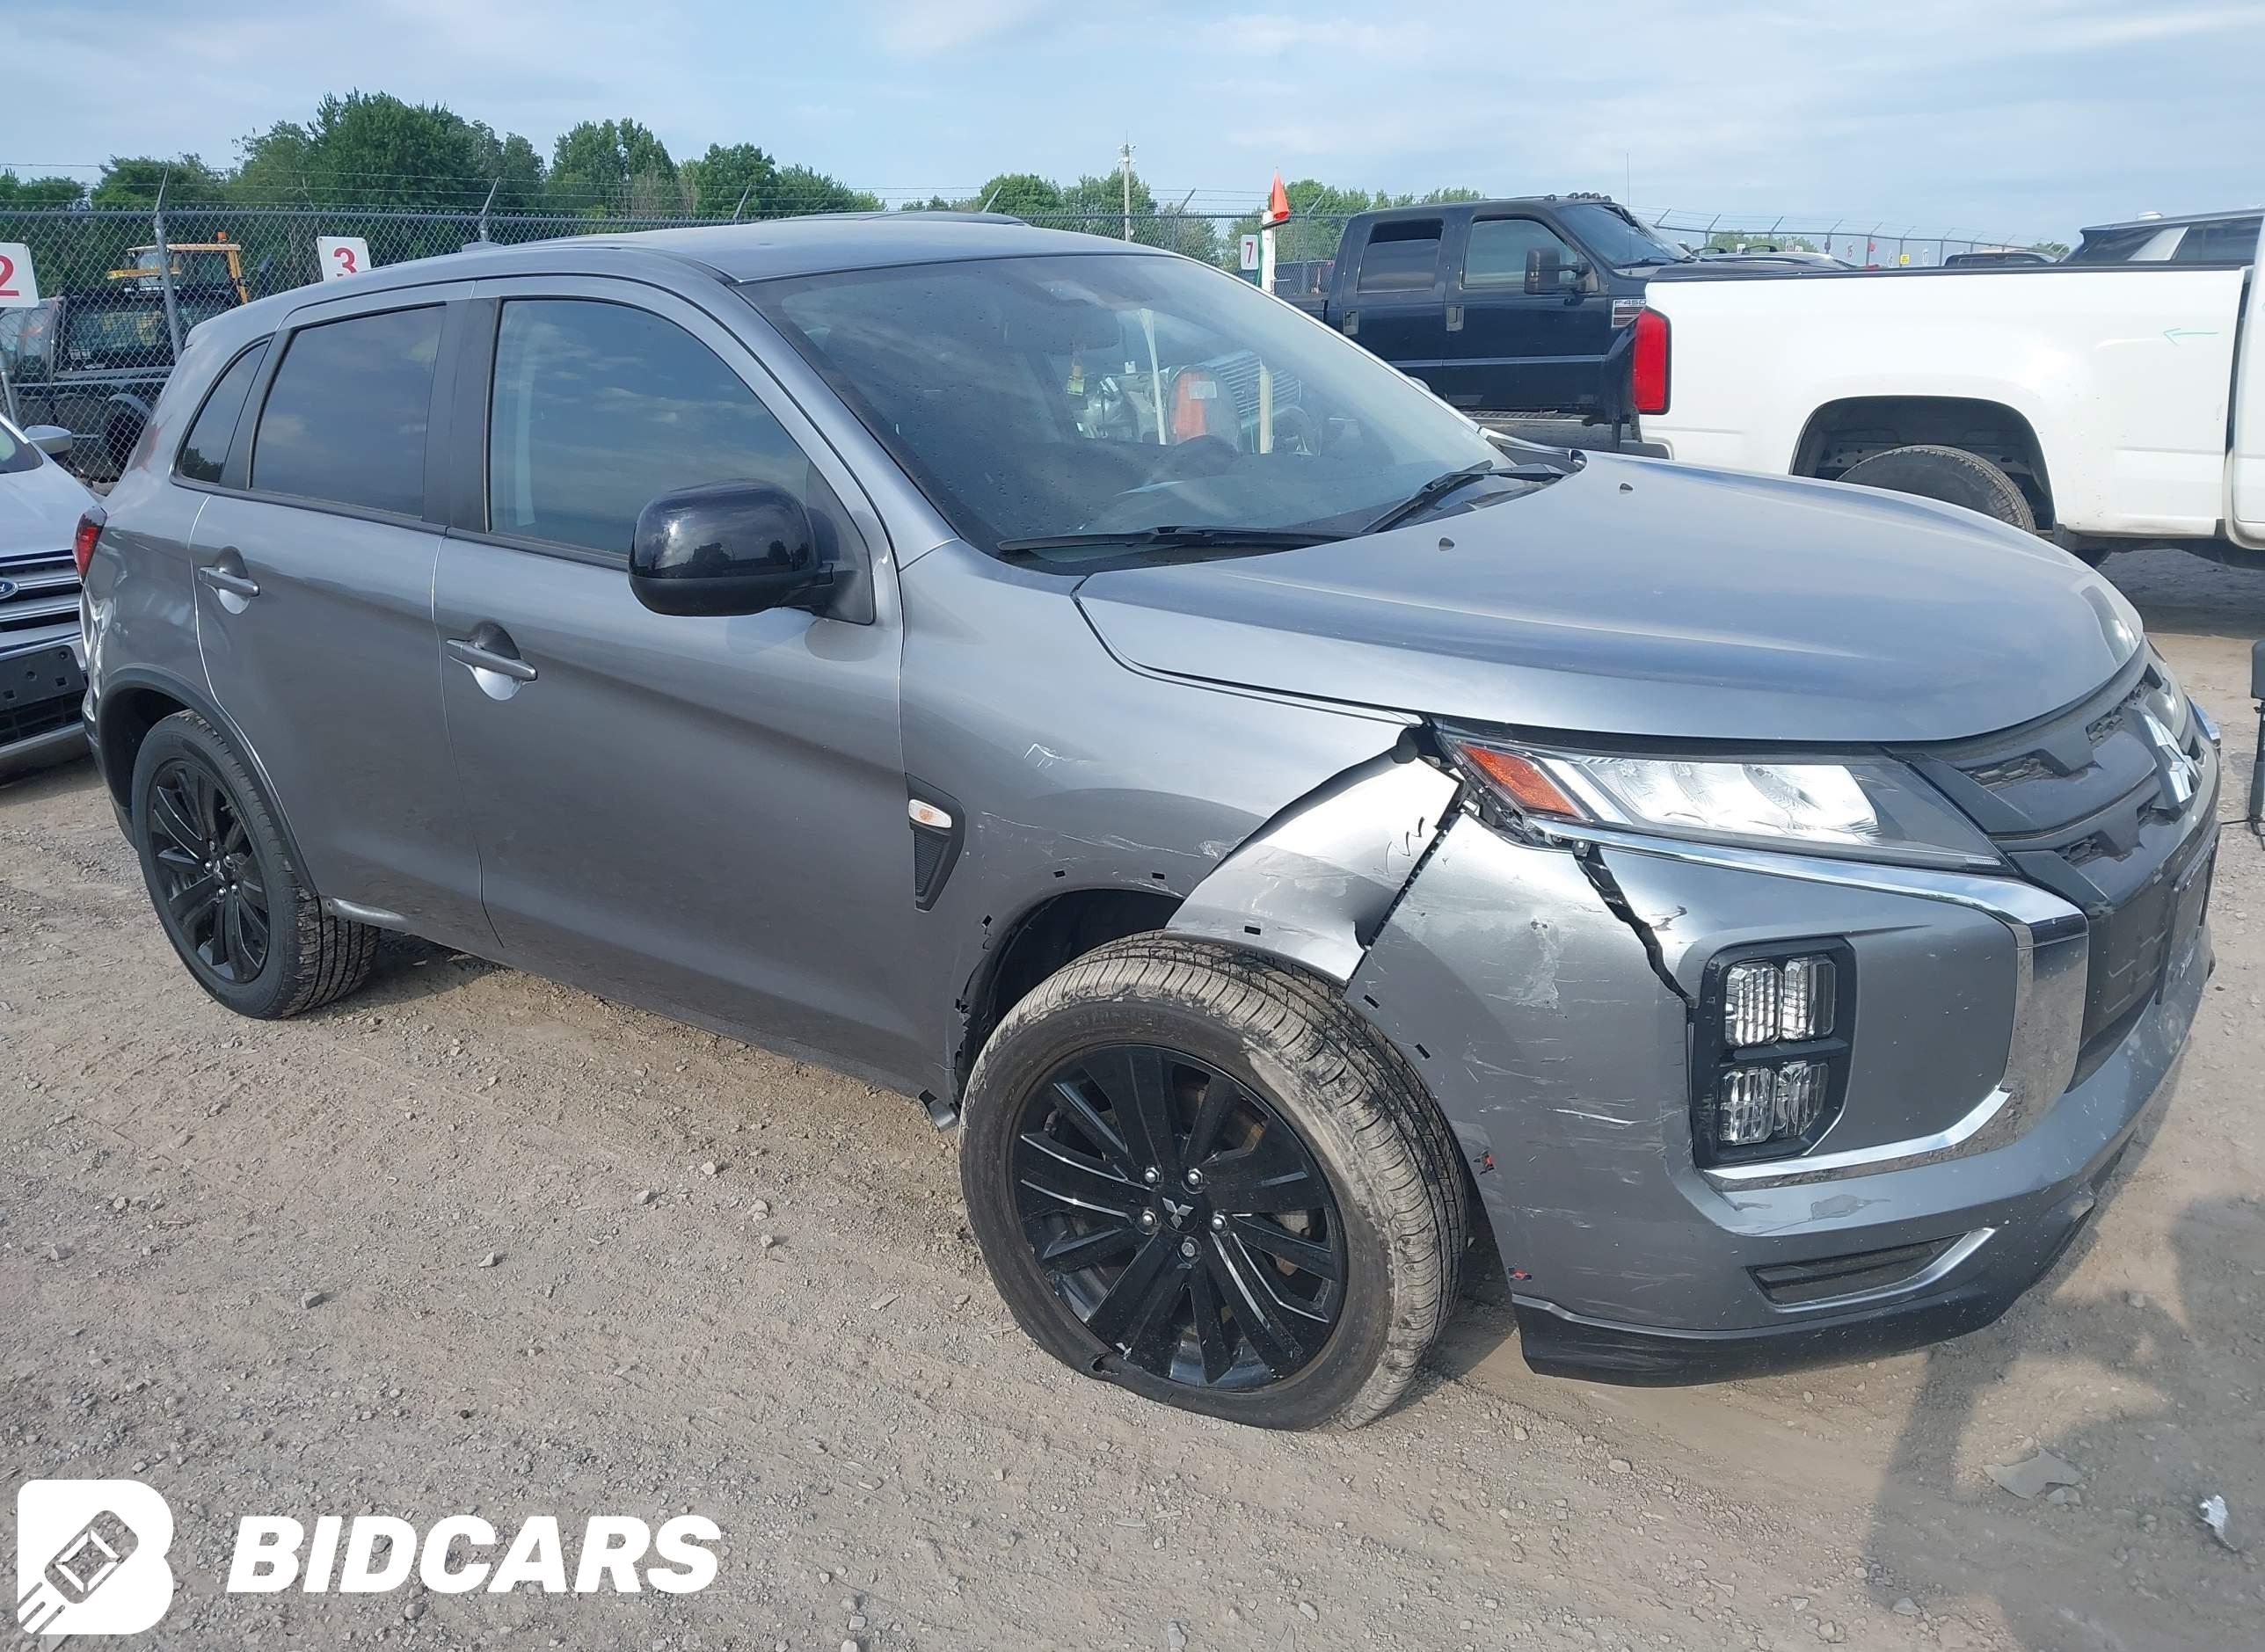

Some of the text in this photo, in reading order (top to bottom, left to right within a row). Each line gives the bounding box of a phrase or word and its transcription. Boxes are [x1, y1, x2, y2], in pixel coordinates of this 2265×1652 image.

[333, 247, 357, 277] 3
[1245, 241, 1253, 264] 7
[0, 255, 19, 295] 2
